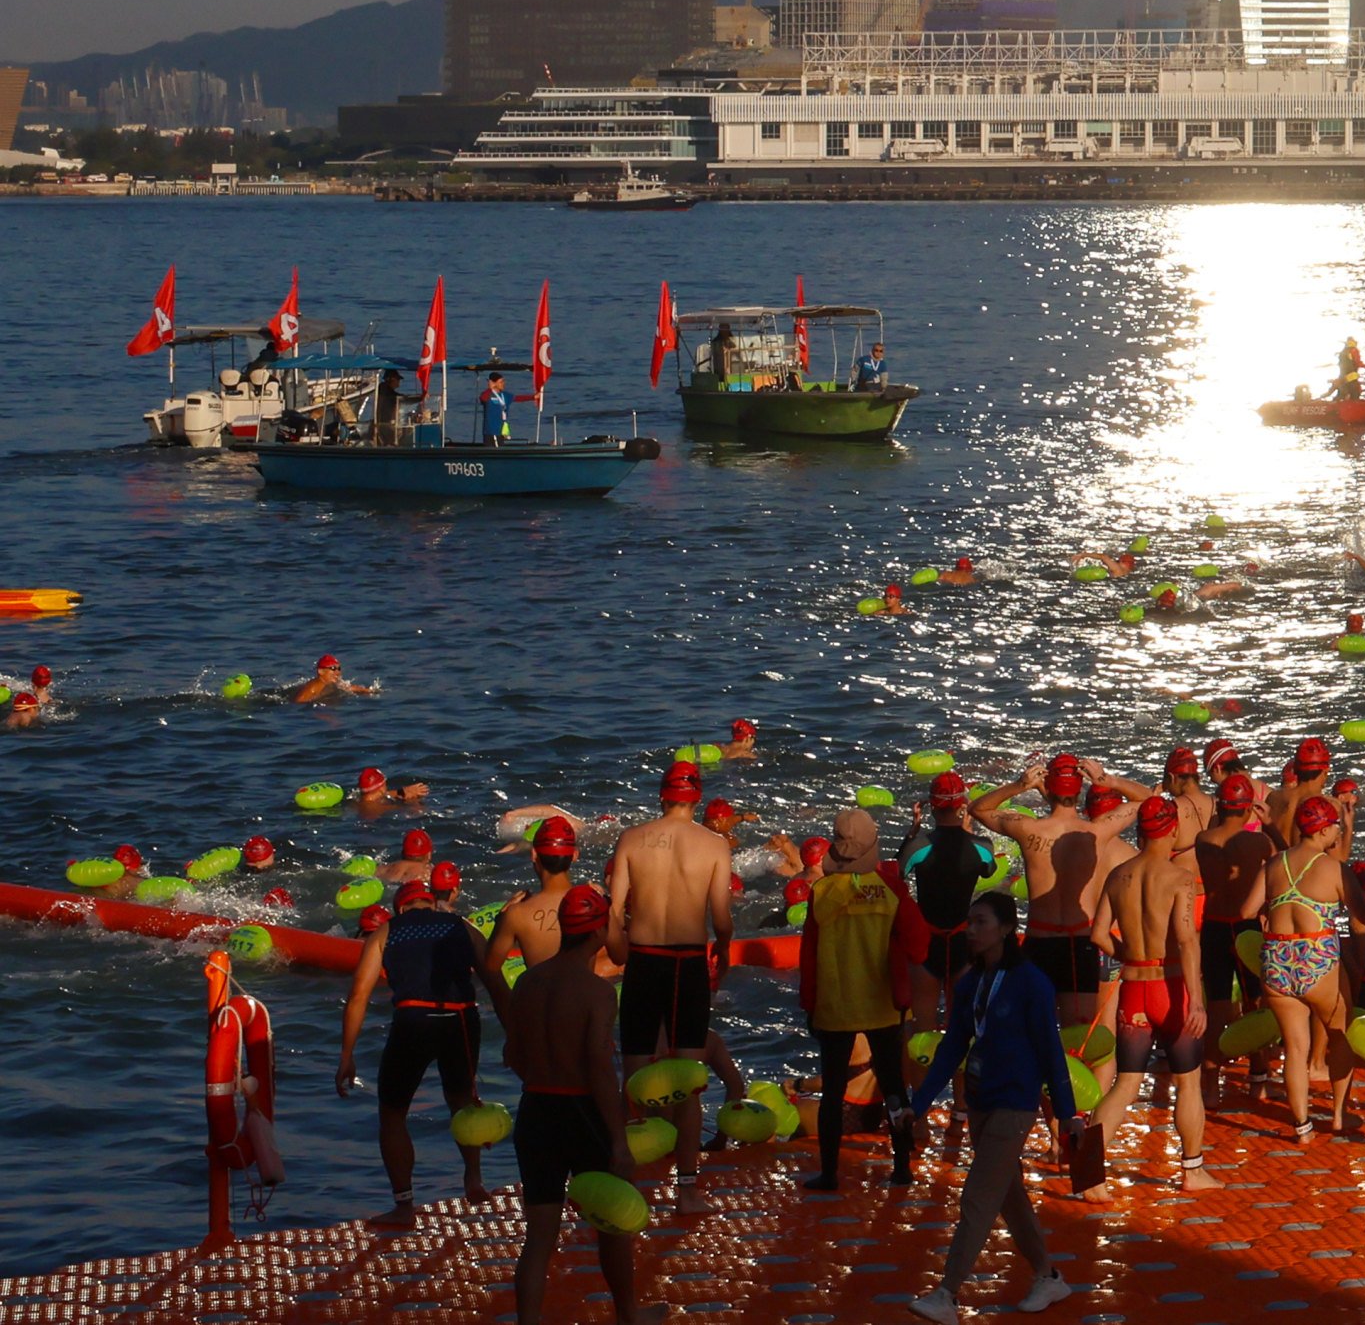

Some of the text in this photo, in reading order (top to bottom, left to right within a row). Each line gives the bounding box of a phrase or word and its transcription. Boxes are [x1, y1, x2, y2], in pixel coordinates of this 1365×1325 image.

[1301, 405, 1327, 415] RESCUE
[444, 461, 485, 477] 709603
[532, 908, 557, 931] 92
